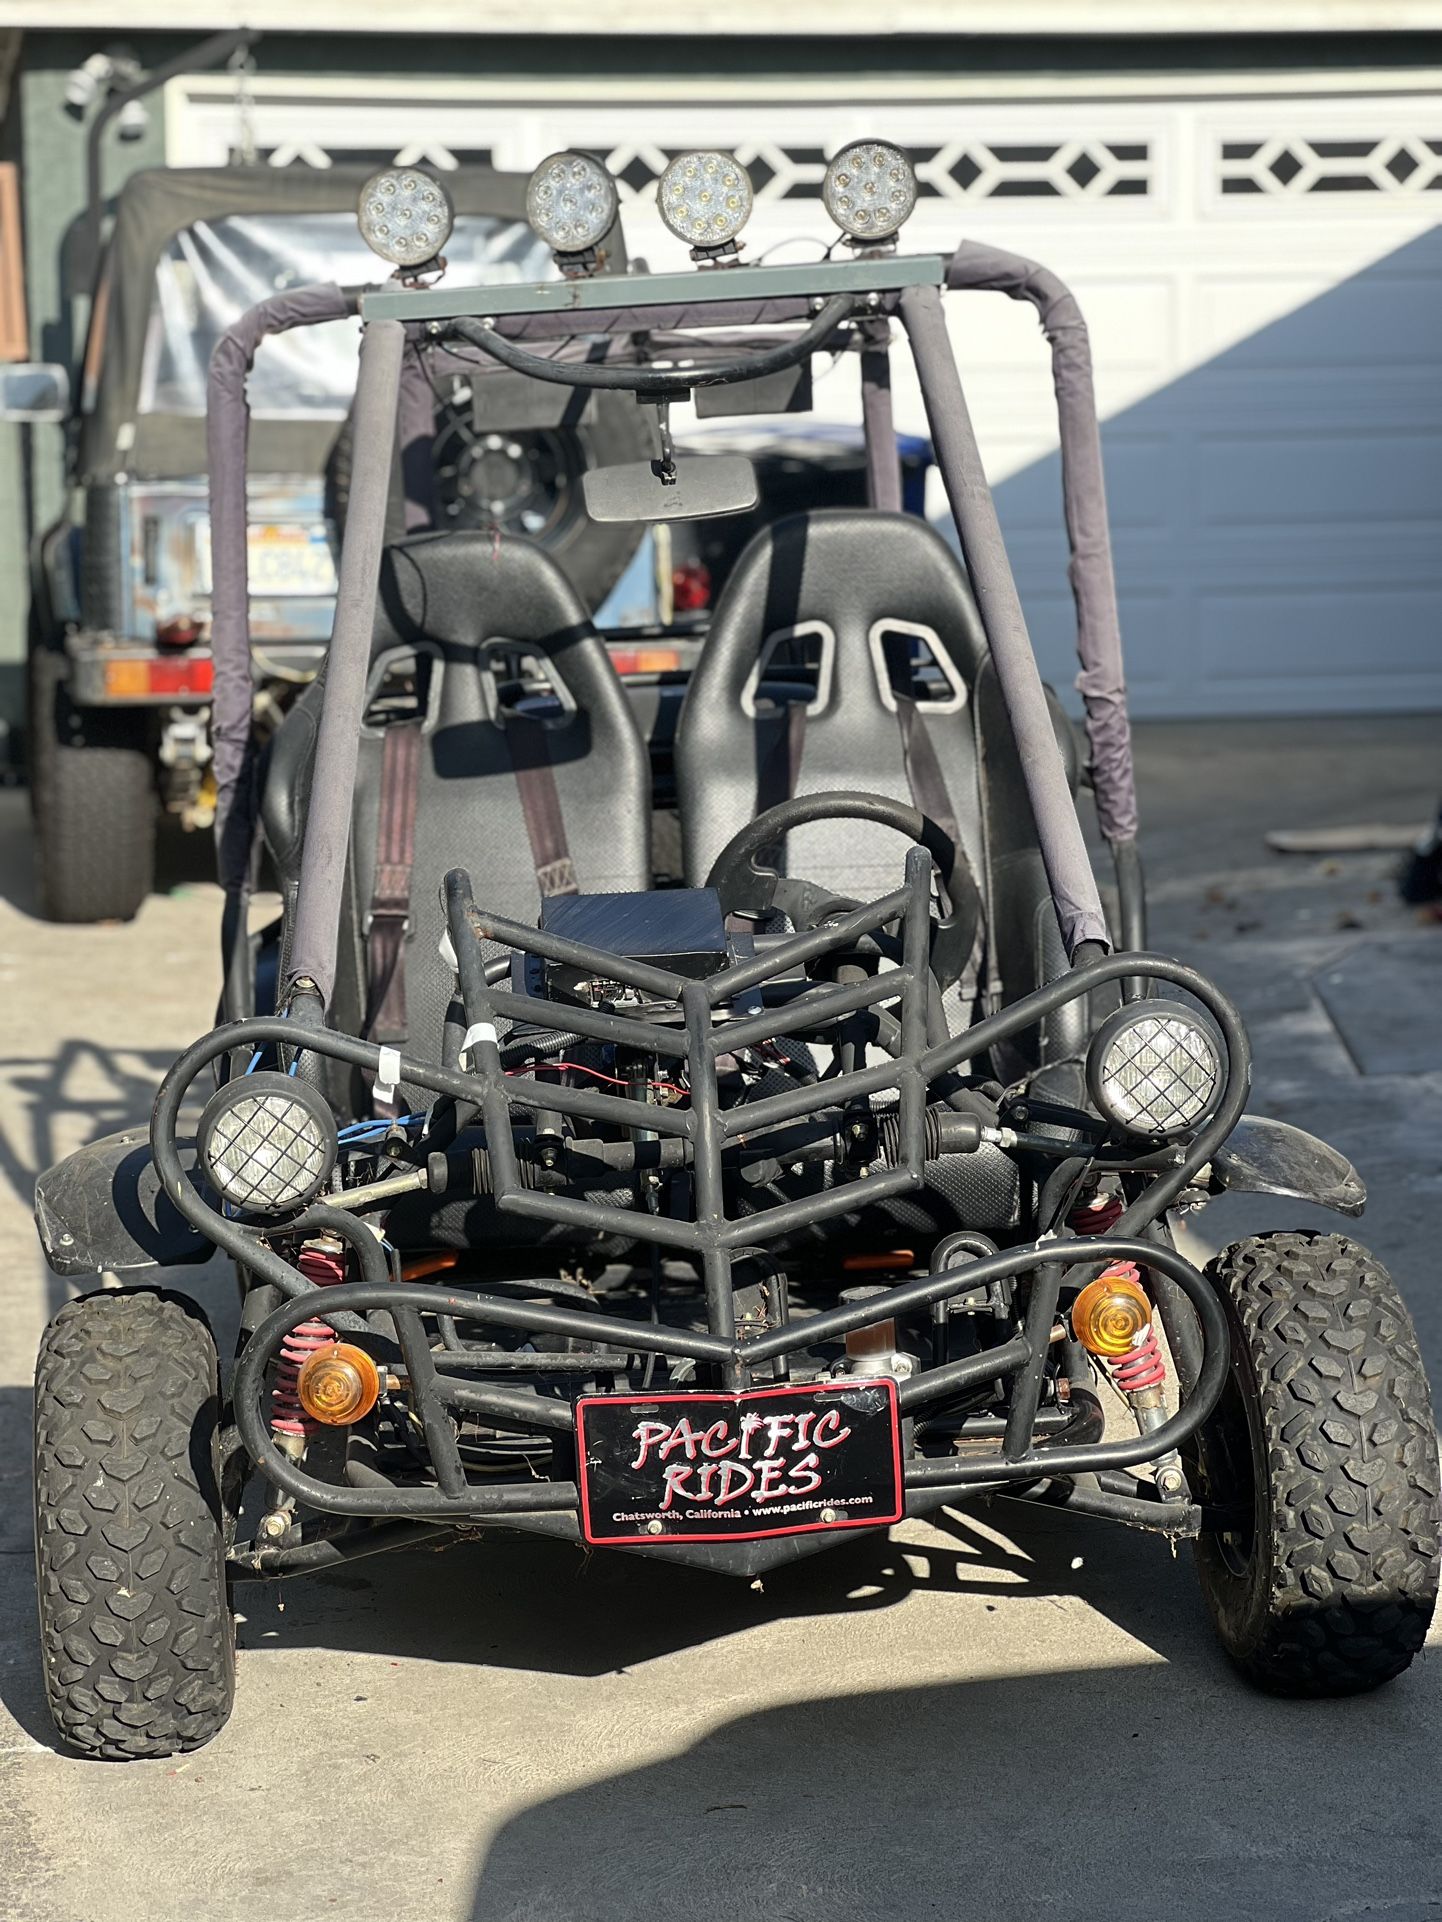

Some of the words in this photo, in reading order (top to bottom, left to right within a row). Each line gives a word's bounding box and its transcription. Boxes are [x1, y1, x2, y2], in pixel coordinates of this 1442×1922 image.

[631, 1409, 851, 1470] PACIFIC
[612, 1509, 684, 1522] Chatsworth,
[685, 1508, 742, 1519] California
[752, 1495, 874, 1516] www.pacificrides.com
[659, 1452, 822, 1510] RIDES
